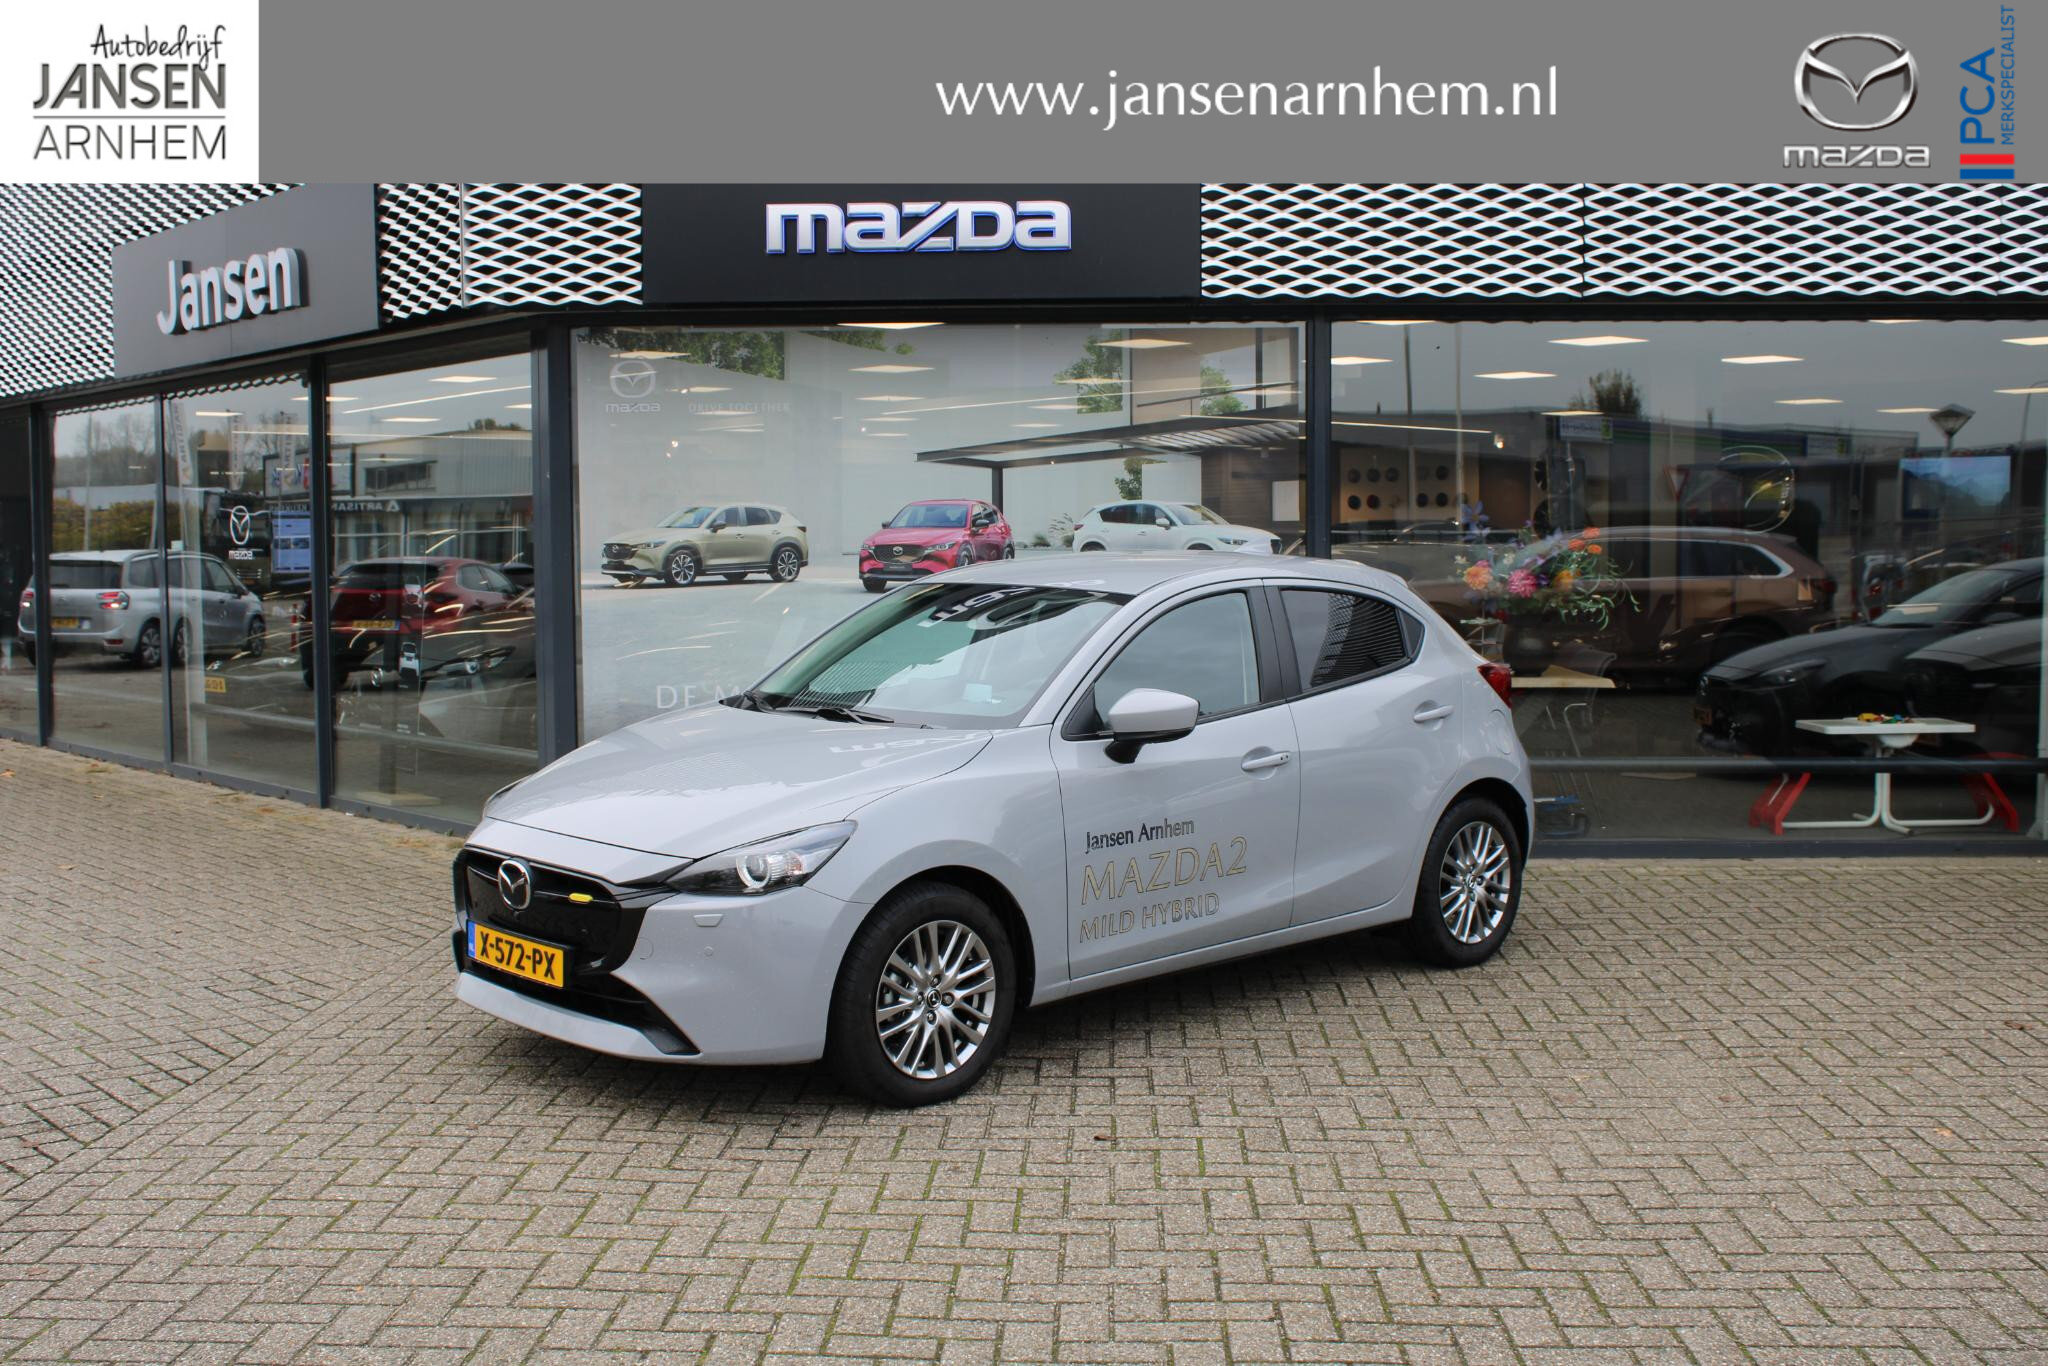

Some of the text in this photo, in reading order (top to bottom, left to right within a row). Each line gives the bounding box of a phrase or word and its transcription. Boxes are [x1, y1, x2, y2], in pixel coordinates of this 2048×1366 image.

[766, 201, 1072, 253] mazda
[156, 247, 301, 335] Jansen
[605, 402, 662, 413] mazda
[1085, 818, 1195, 854] Jansen Arnhem
[1081, 836, 1248, 905] MAZDA2
[1079, 893, 1220, 944] MILD HYBRID
[480, 931, 556, 980] X-572-PX
